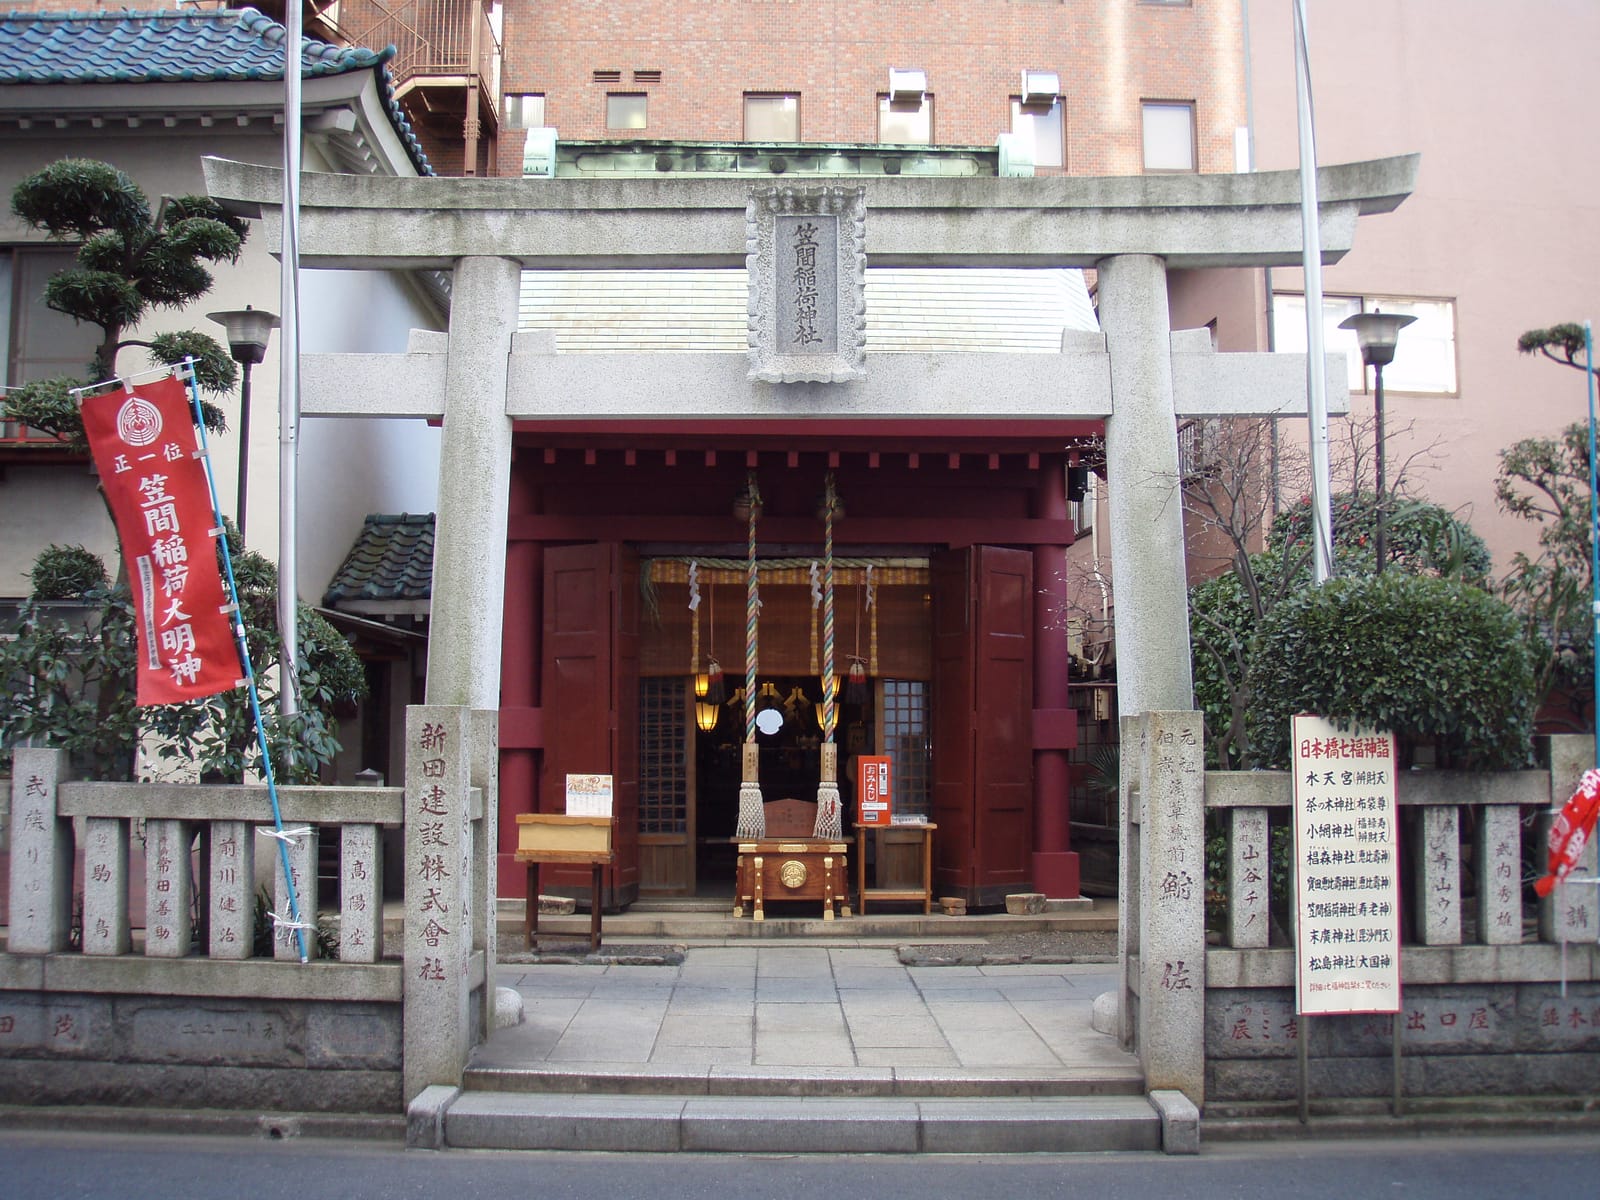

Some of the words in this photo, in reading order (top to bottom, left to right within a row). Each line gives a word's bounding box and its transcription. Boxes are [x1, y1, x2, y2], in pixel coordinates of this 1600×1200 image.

[793, 222, 823, 346] 笠間稲荷神社
[114, 442, 185, 474] 正一位
[138, 474, 203, 686] 笠間稲荷大明神
[865, 765, 876, 801] おみくじ
[1300, 737, 1390, 760] 日本橋七福神詣
[419, 722, 450, 981] 新田建設株式會社
[218, 838, 238, 944] 前川健治
[1406, 1008, 1489, 1031] 出口屋
